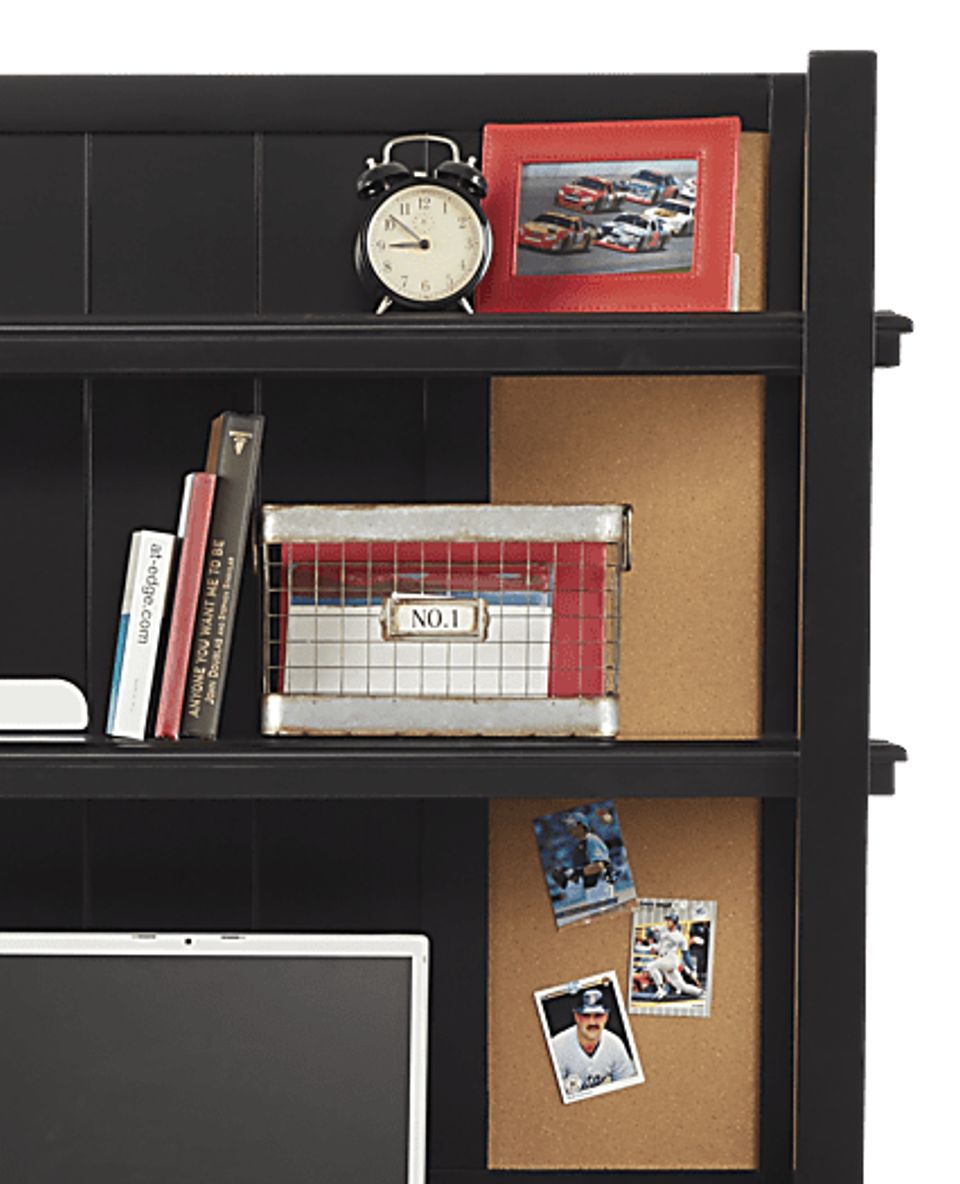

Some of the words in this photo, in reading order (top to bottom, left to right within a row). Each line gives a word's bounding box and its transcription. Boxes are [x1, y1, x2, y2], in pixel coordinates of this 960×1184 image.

[400, 203, 411, 215] 11
[419, 197, 431, 210] 12
[400, 275, 409, 288] 7
[420, 280, 431, 291] 6
[211, 539, 224, 555] BE
[208, 559, 221, 574] TO
[137, 543, 163, 644] at-edge.com
[205, 579, 219, 596] ME
[200, 600, 216, 636] WANT
[412, 607, 458, 628] NO.1
[196, 638, 210, 664] YOU
[188, 665, 206, 718] ANYONE
